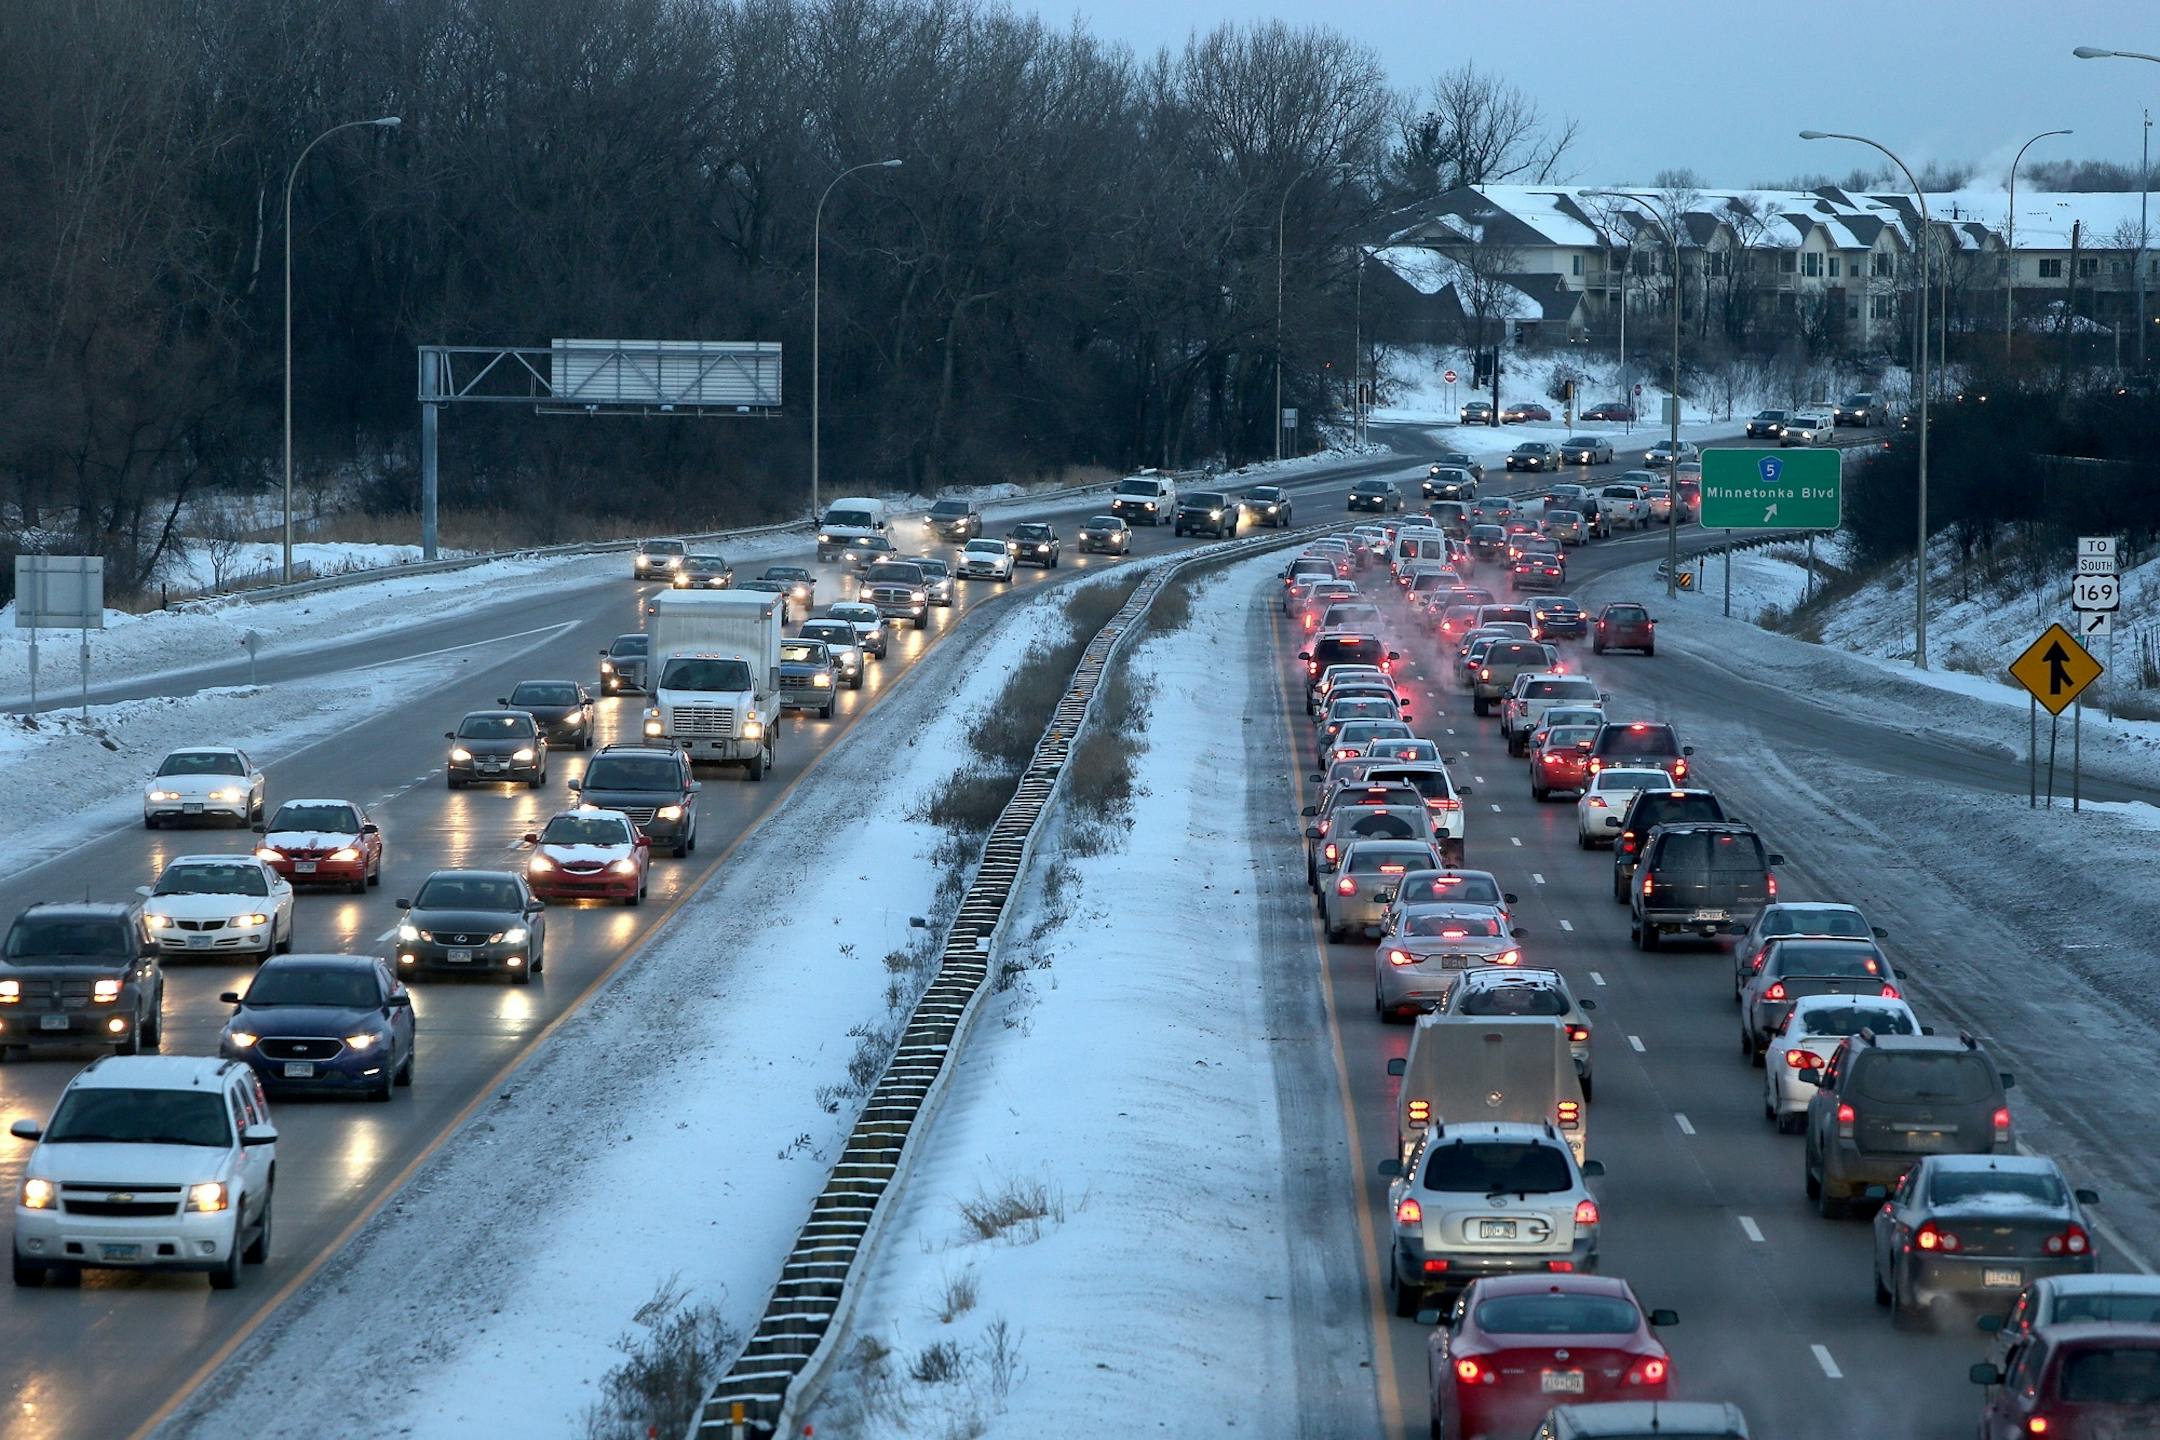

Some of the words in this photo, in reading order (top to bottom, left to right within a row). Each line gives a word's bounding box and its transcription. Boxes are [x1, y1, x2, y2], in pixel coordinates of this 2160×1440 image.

[1766, 464, 1775, 477] 5
[1707, 487, 1794, 498] Minnetonka
[1801, 487, 1834, 498] Blvd
[2087, 541, 2107, 552] TO
[2081, 559, 2112, 571] SOUTH
[2080, 584, 2112, 601] 169
